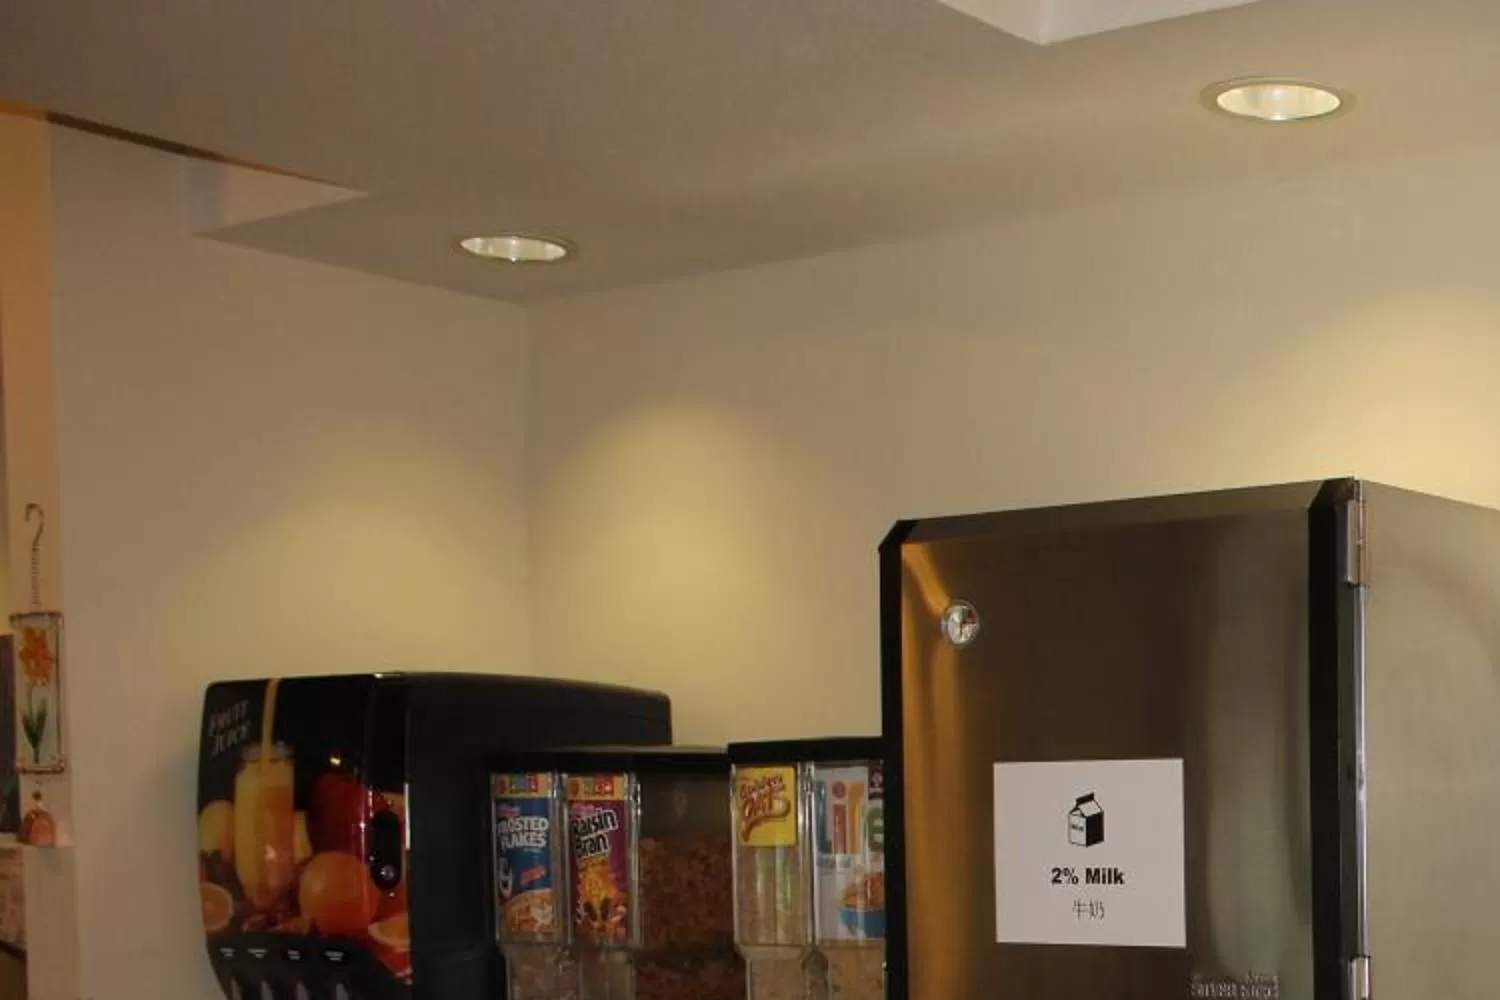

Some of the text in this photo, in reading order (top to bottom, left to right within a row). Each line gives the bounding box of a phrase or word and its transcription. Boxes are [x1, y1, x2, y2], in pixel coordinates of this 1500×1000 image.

[571, 808, 619, 834] Raisin
[574, 832, 611, 856] Bran
[1051, 867, 1125, 885] 2% Milk
